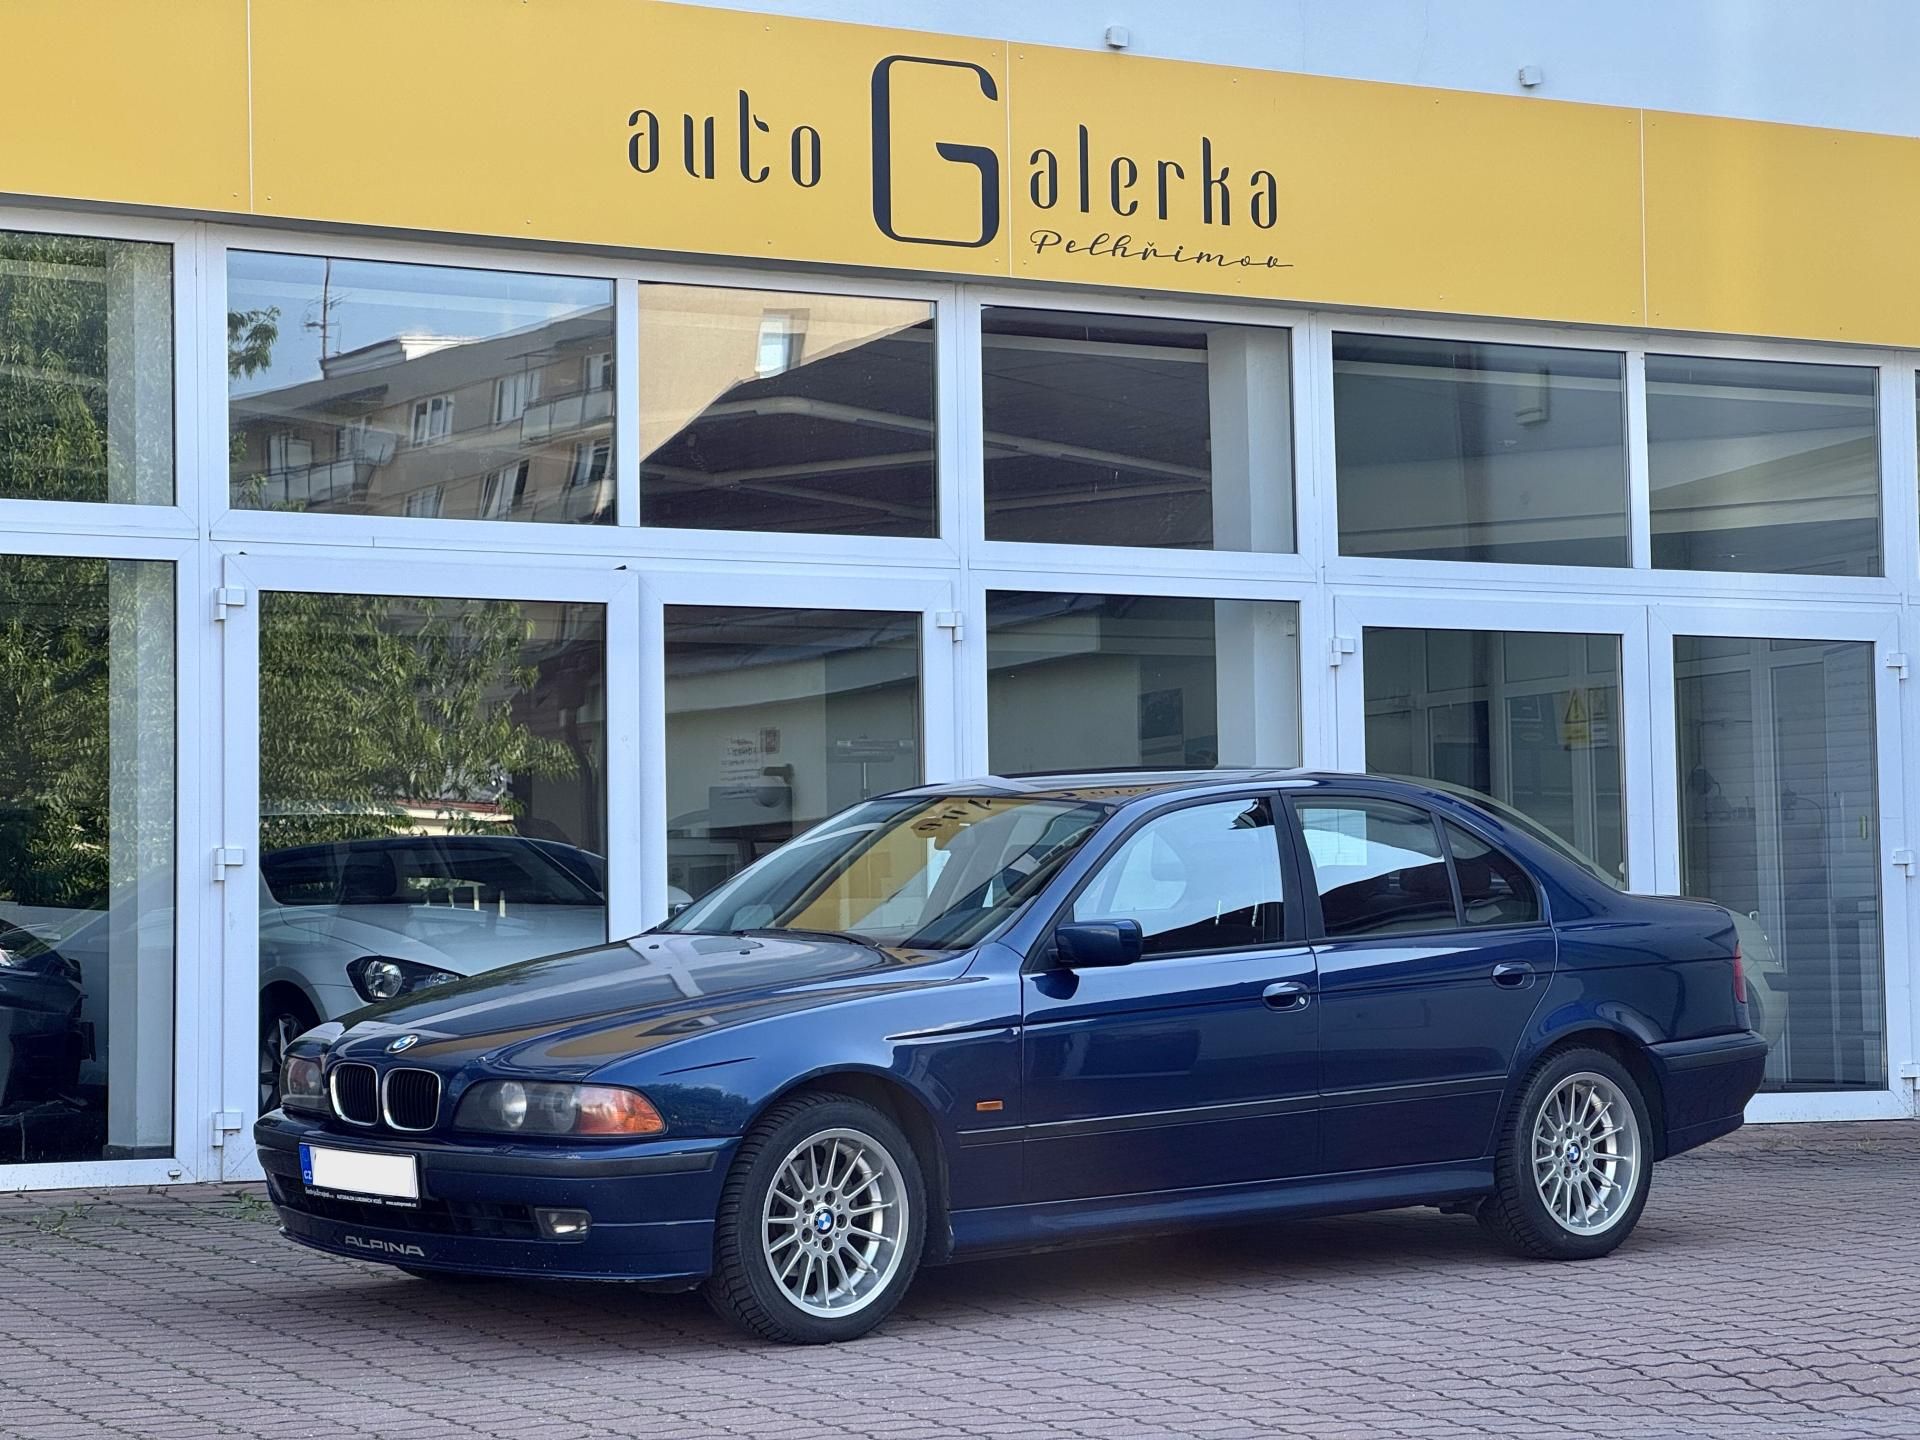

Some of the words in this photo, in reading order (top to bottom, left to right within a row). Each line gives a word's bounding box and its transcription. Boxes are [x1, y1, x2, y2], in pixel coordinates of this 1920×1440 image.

[628, 89, 821, 188] auto
[1030, 229, 1294, 268] Pelhřimov
[303, 1170, 313, 1180] CZ
[344, 1235, 425, 1257] ALPINA
